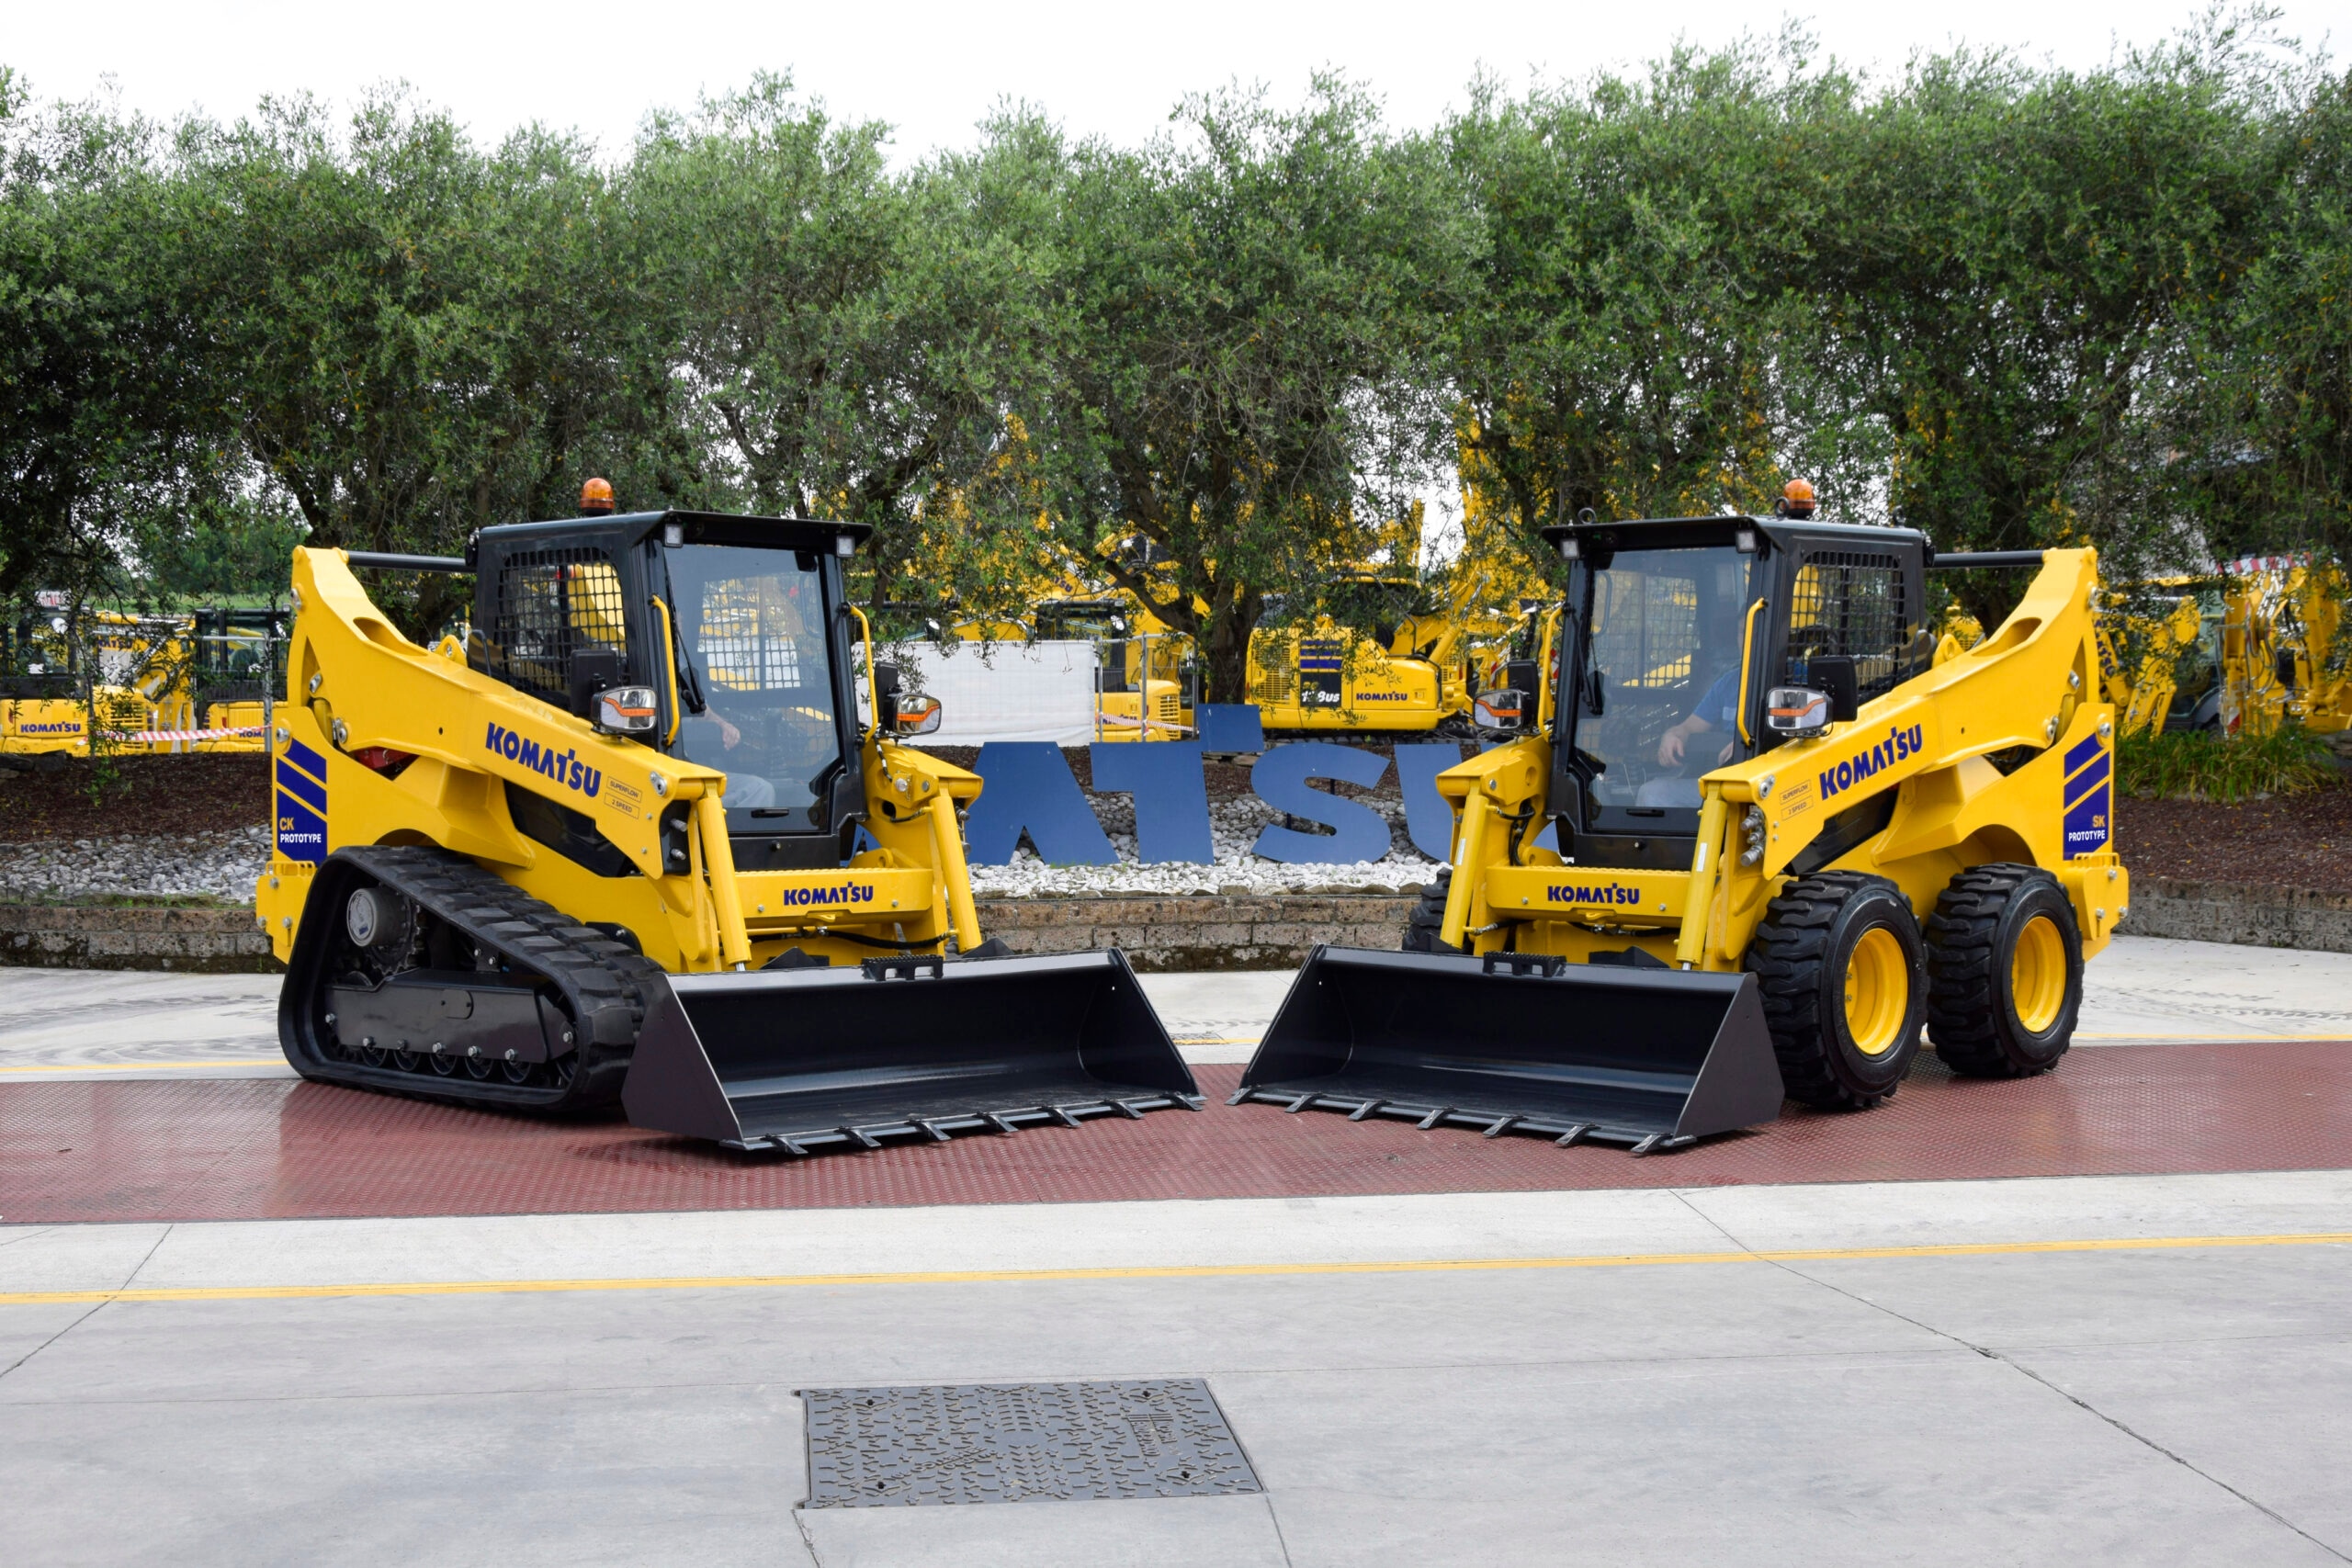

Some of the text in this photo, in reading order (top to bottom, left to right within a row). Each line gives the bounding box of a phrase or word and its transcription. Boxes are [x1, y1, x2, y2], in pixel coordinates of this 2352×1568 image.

[1356, 691, 1408, 701] KOMATSU
[20, 721, 81, 733] KOMATSU
[485, 721, 602, 798] KOMATSU
[1819, 723, 1923, 801] KOMATSU
[610, 780, 639, 798] SUPERFLOW
[1782, 784, 1808, 800] SUPERFLOW
[616, 800, 632, 813] SPEED
[1792, 802, 1807, 814] SPEED
[279, 818, 295, 831] CK
[2092, 815, 2106, 828] SK
[279, 833, 322, 843] PROTOTYPE
[2068, 829, 2106, 842] PROTOTYPE
[783, 881, 874, 906] KOMATSU
[1547, 882, 1640, 905] KOMATSU
